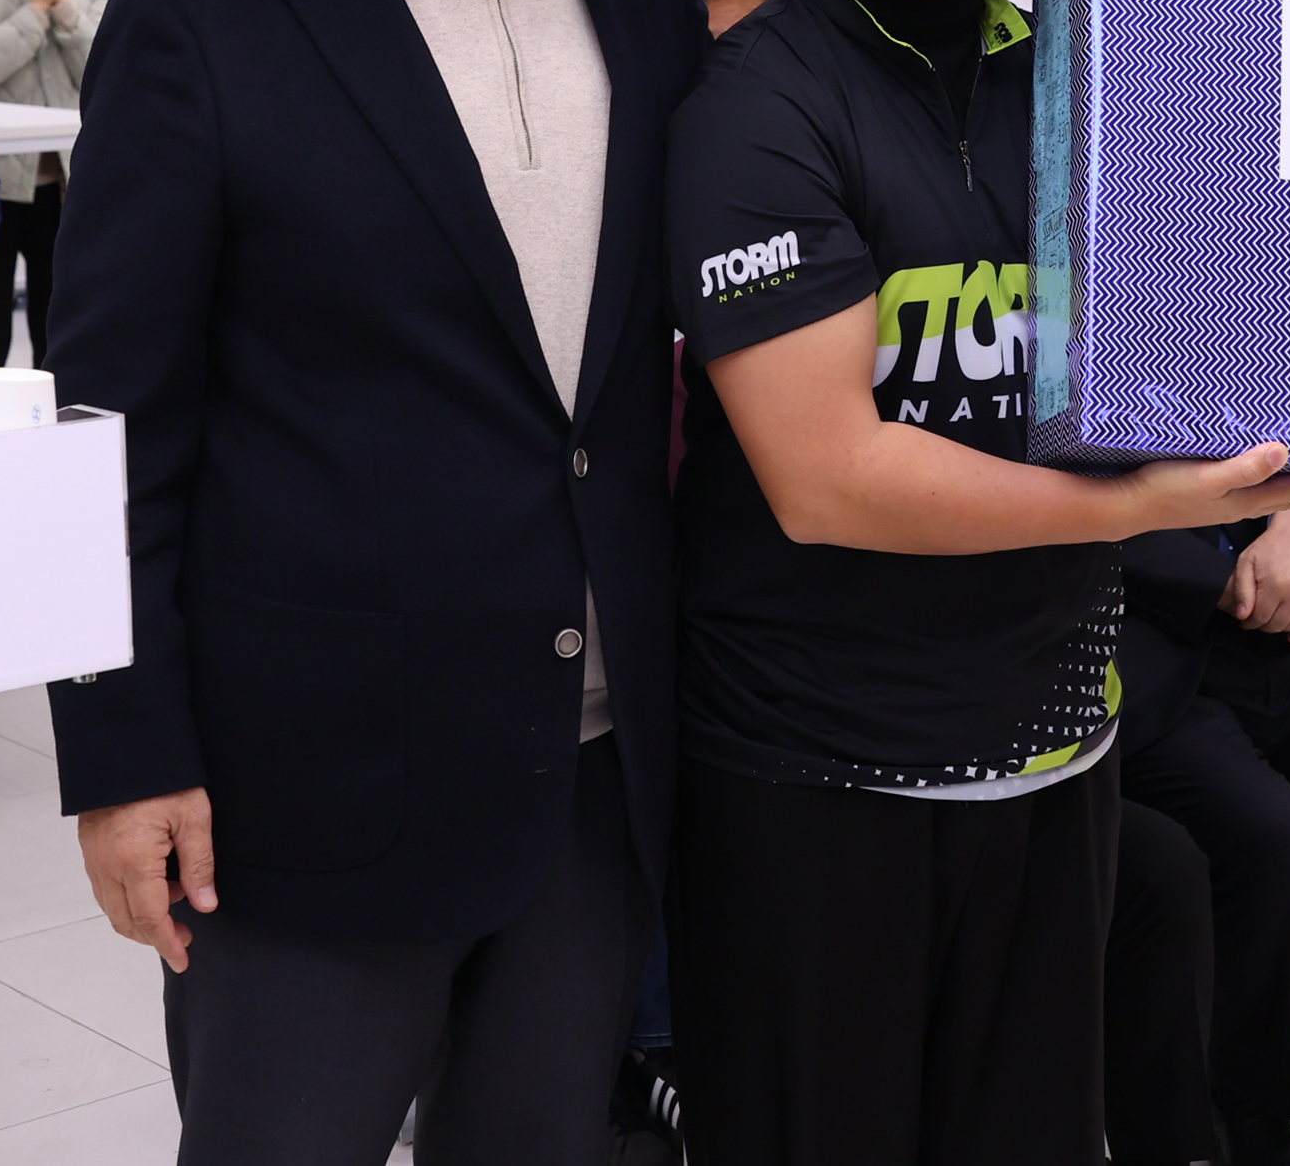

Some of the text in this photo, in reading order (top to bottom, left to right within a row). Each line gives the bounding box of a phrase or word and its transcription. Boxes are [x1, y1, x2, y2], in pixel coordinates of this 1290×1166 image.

[701, 230, 801, 298] STORM
[718, 271, 796, 304] NATION
[872, 260, 1028, 388] STOR
[897, 392, 1023, 423] NATI
